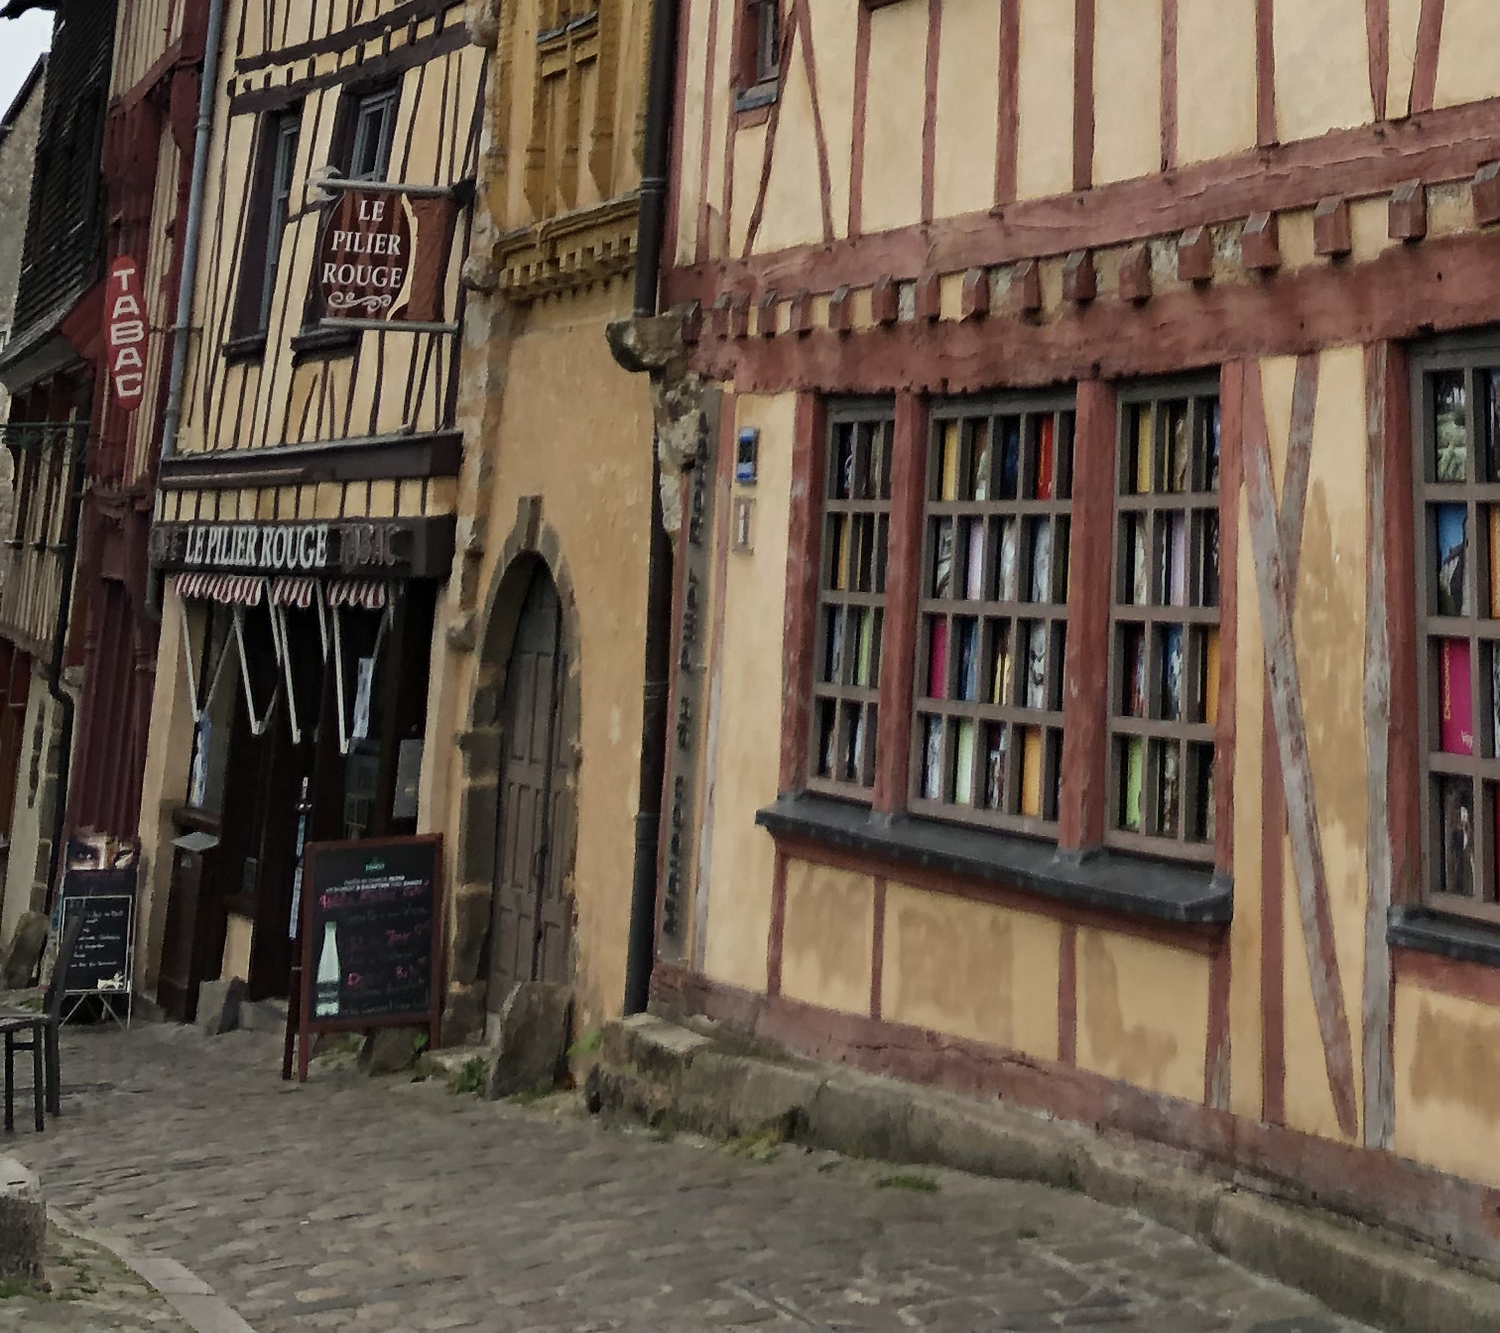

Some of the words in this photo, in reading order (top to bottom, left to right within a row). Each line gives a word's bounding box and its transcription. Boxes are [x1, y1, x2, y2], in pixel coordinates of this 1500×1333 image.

[358, 200, 386, 222] LE
[331, 230, 401, 255] PILIER
[321, 262, 403, 288] ROUGE
[110, 268, 145, 398] TABAC
[184, 524, 205, 564] LE
[205, 524, 258, 567] PILIER
[259, 523, 328, 569] ROUGE
